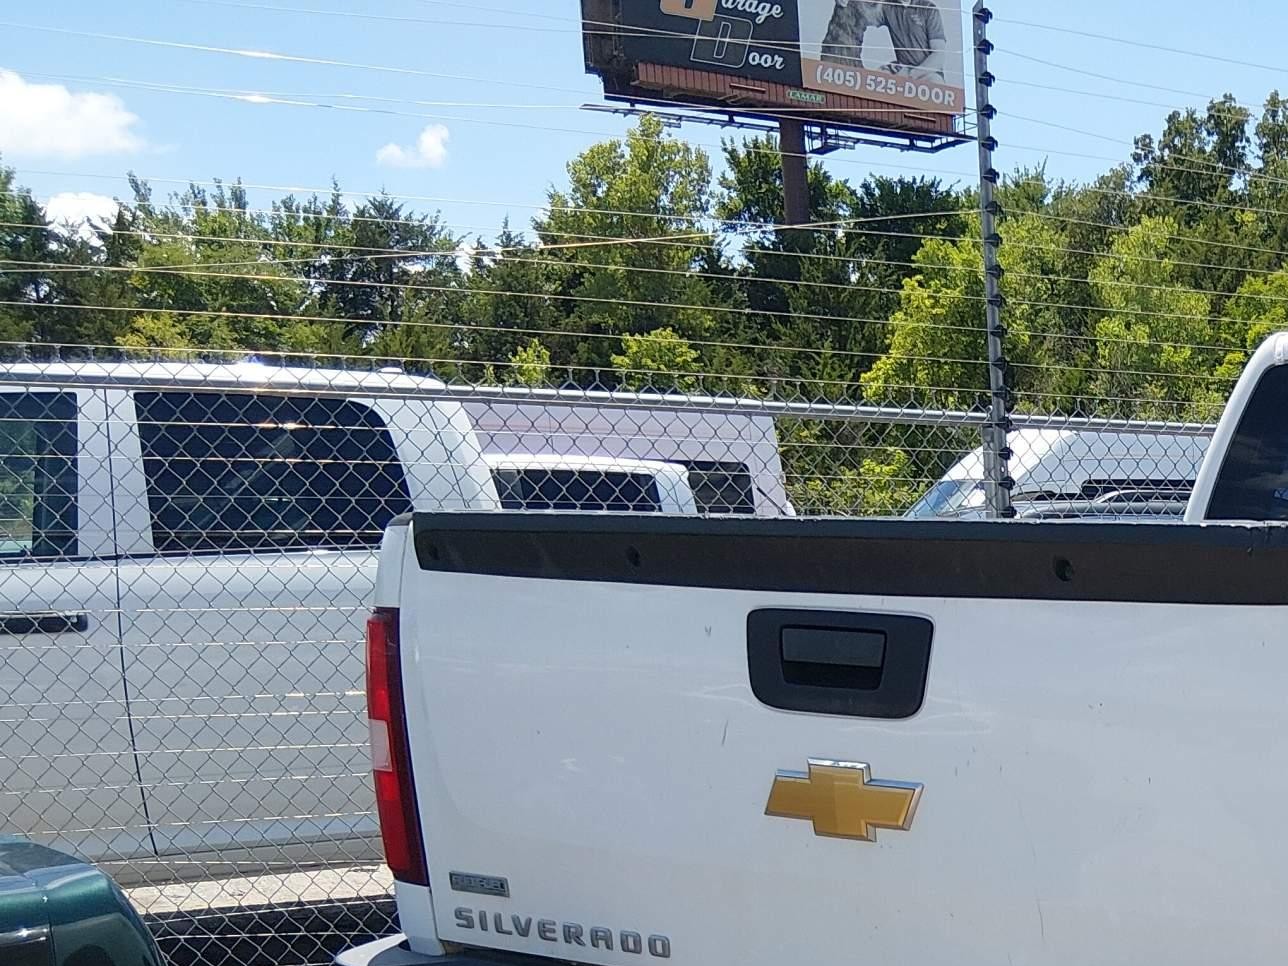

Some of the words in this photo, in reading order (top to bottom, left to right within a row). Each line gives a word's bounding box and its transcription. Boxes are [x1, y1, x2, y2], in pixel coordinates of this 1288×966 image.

[816, 64, 862, 91] (405)
[865, 75, 956, 107] 525-DOOR
[454, 906, 672, 959] SILVERADO
